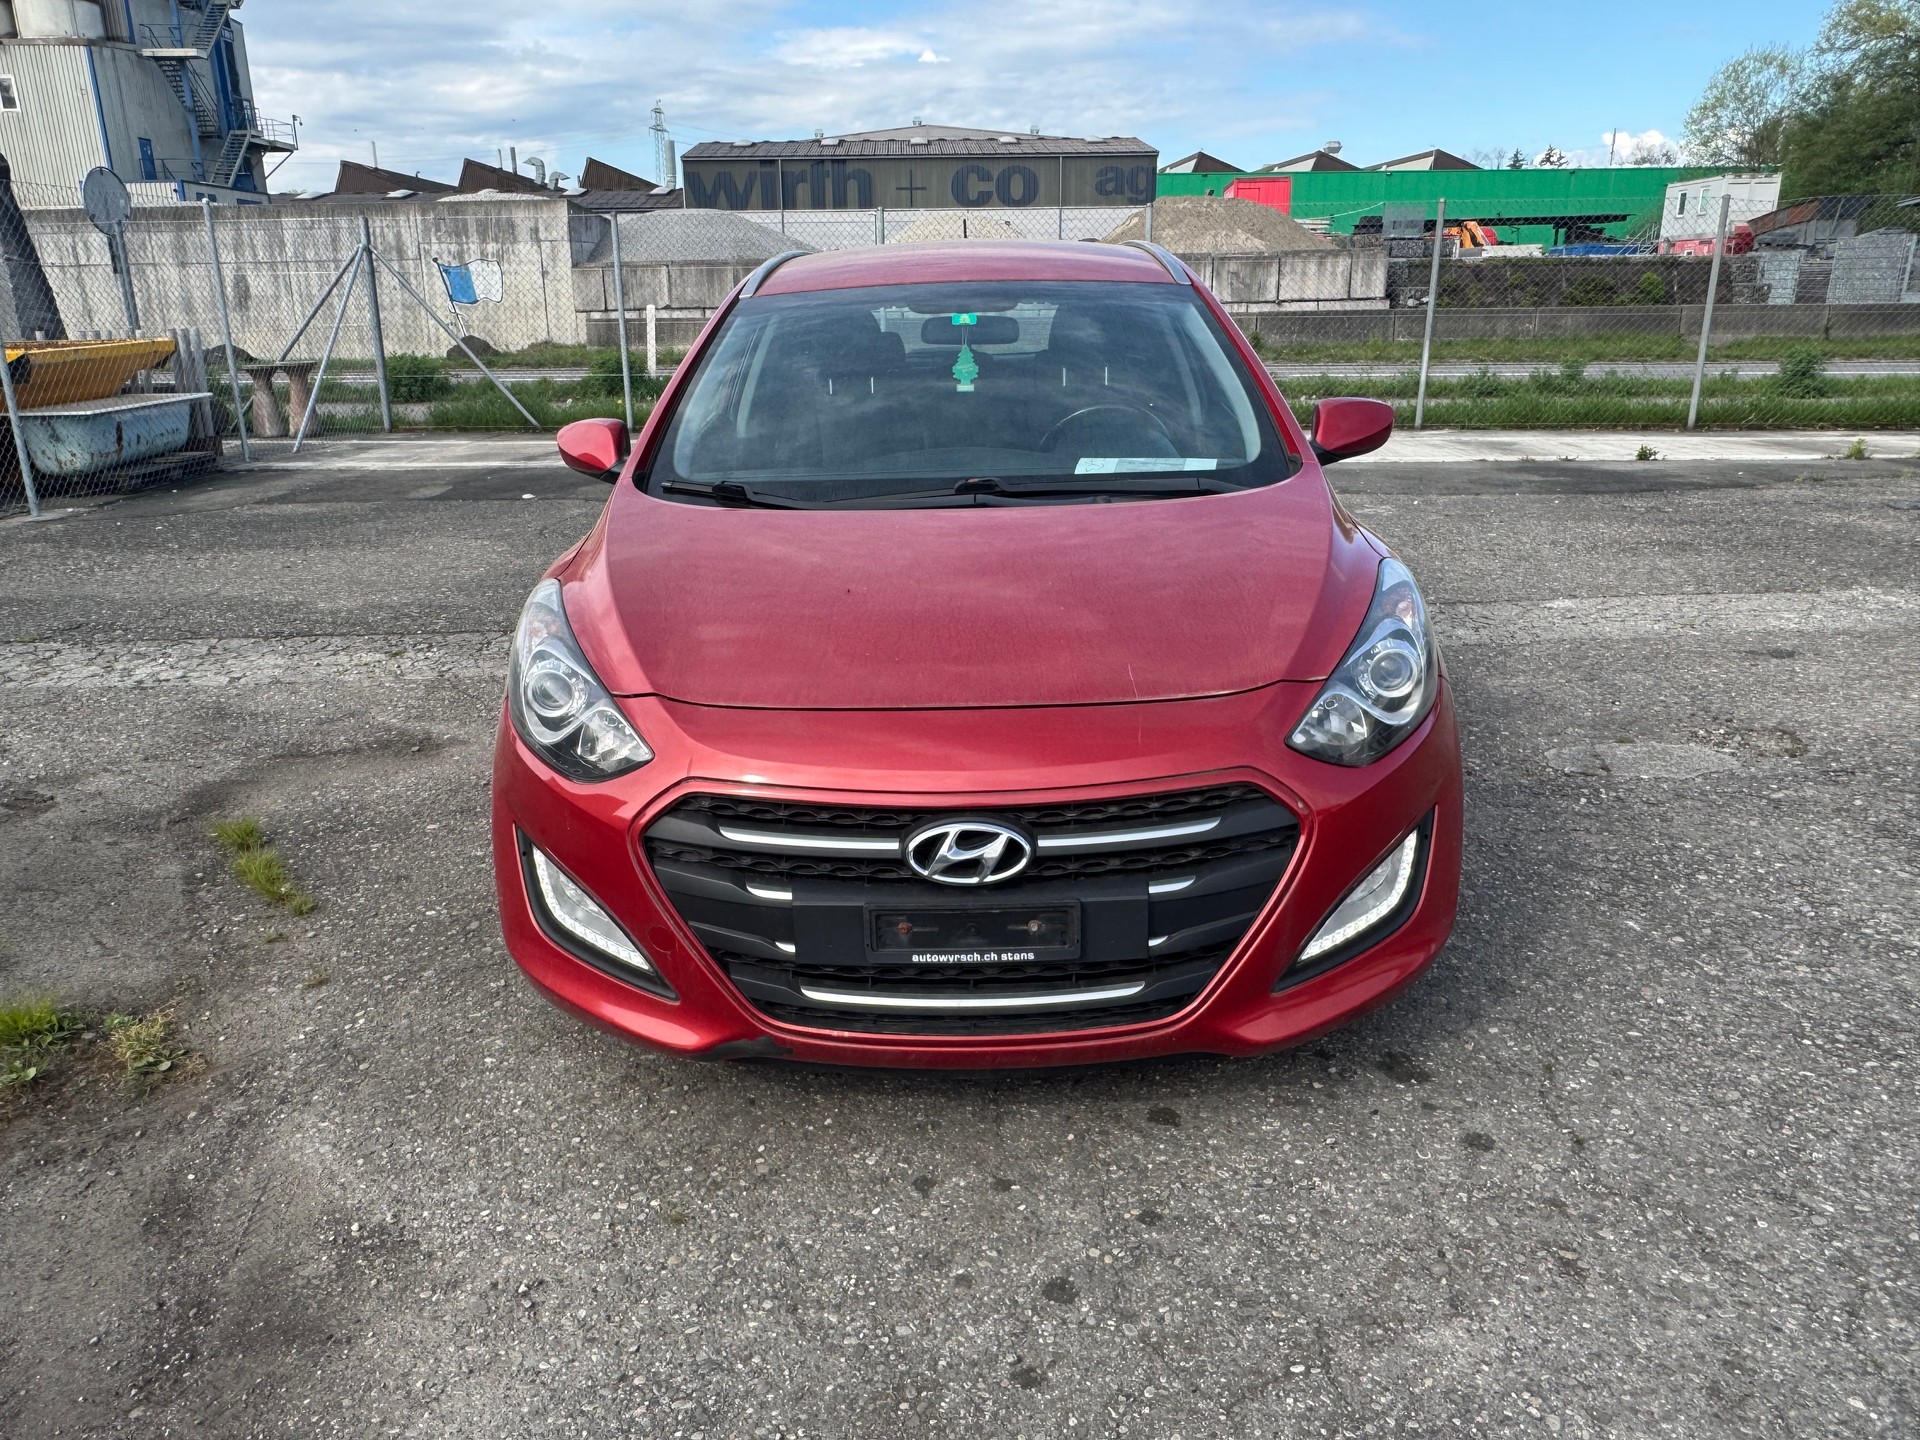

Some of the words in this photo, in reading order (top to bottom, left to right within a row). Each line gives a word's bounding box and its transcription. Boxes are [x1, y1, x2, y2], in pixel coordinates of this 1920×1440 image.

[684, 160, 874, 210] wirth
[951, 164, 1039, 208] co
[1095, 165, 1157, 206] ag
[911, 952, 998, 964] autowyrsch.ch
[1001, 952, 1035, 961] stans
